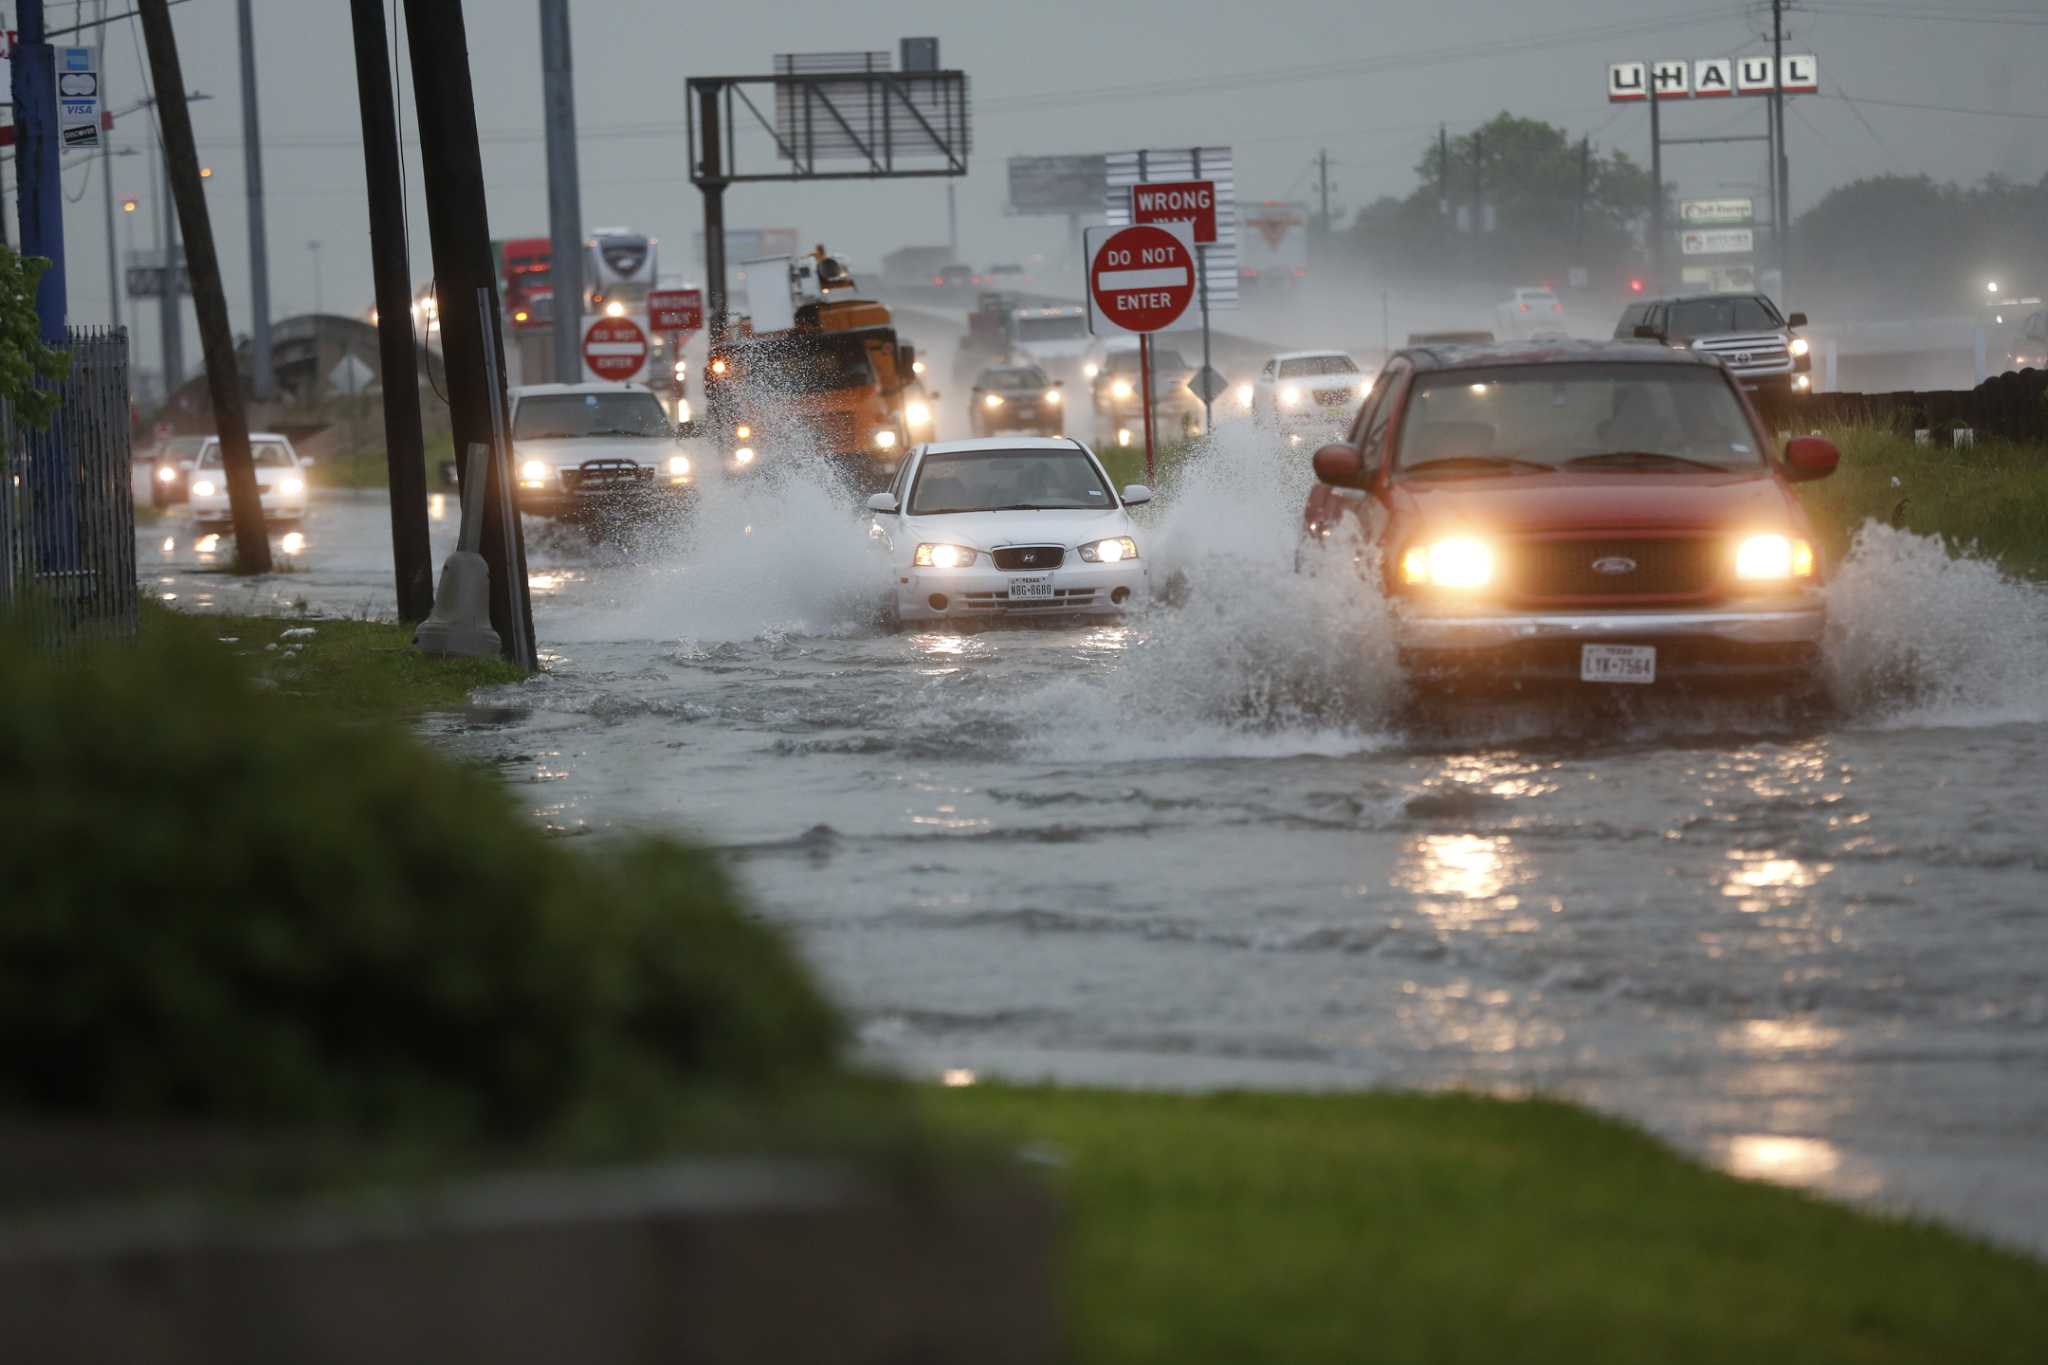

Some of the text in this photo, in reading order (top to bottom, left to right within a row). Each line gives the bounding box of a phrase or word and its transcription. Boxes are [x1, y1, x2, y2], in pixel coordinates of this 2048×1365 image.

[67, 105, 93, 115] VISA
[1137, 191, 1211, 212] WRONG
[1107, 246, 1176, 266] DO NOT
[1116, 292, 1172, 310] ENTER
[597, 356, 634, 368] ENTER
